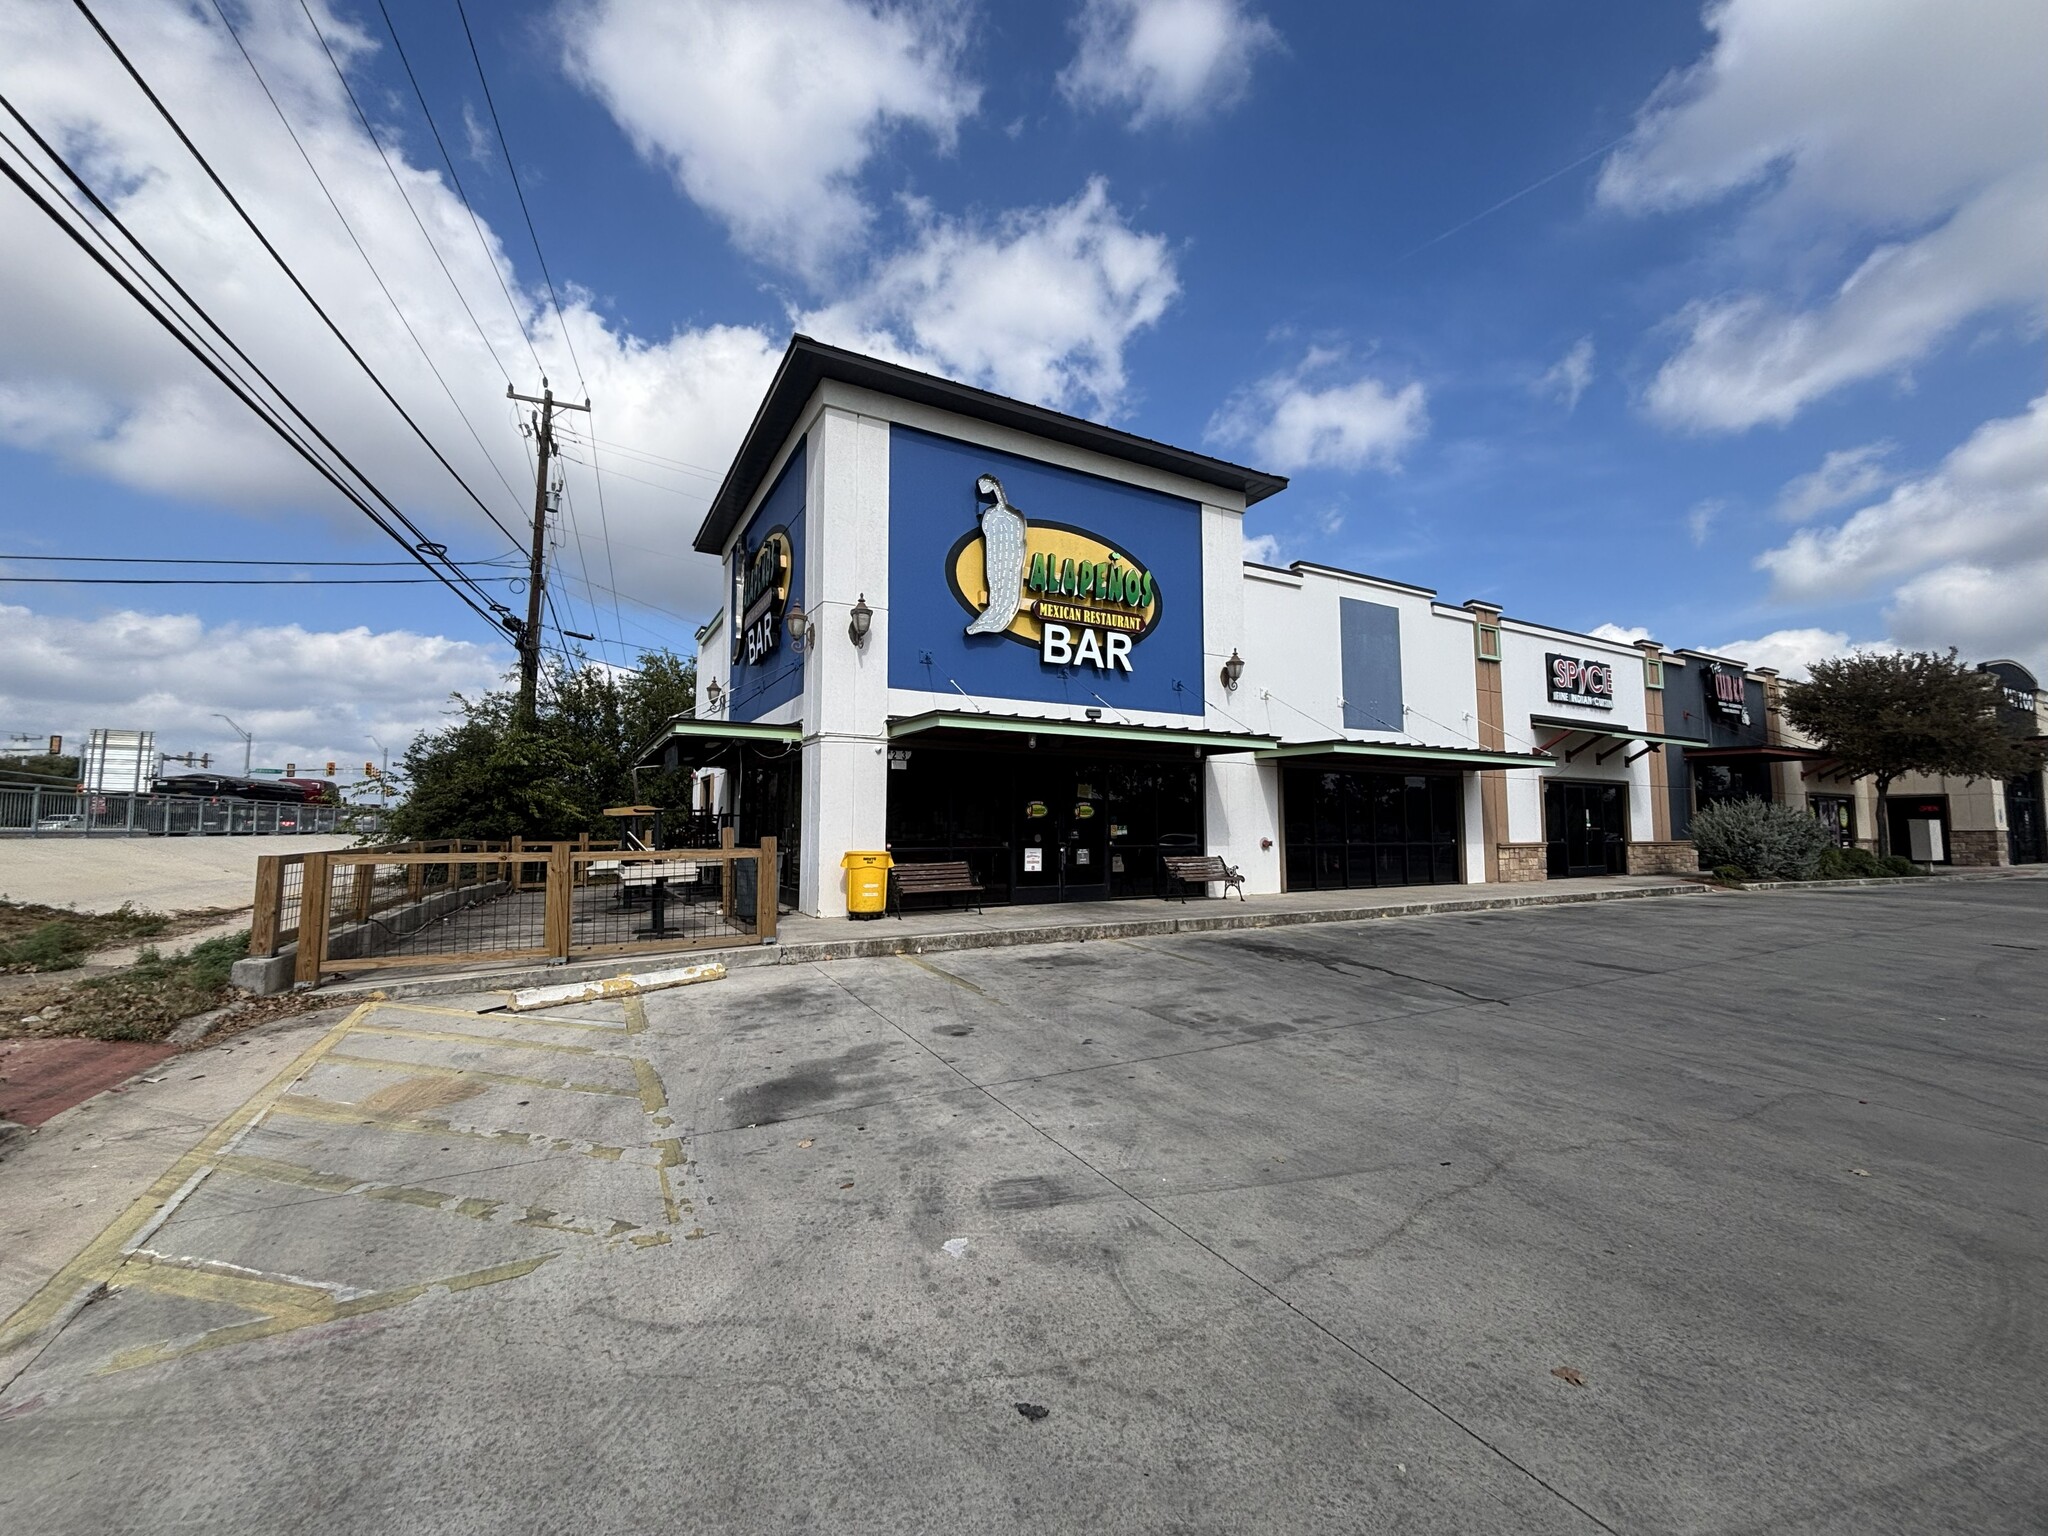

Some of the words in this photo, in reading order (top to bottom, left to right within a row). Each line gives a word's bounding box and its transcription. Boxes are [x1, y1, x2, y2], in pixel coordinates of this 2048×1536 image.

[1039, 602, 1081, 621] MEXICAN
[1083, 609, 1141, 631] RESTAURANT
[748, 611, 773, 666] BAR
[1043, 623, 1134, 673] BAR
[1553, 658, 1614, 695] SPICE
[1569, 693, 1592, 705] INDIAN
